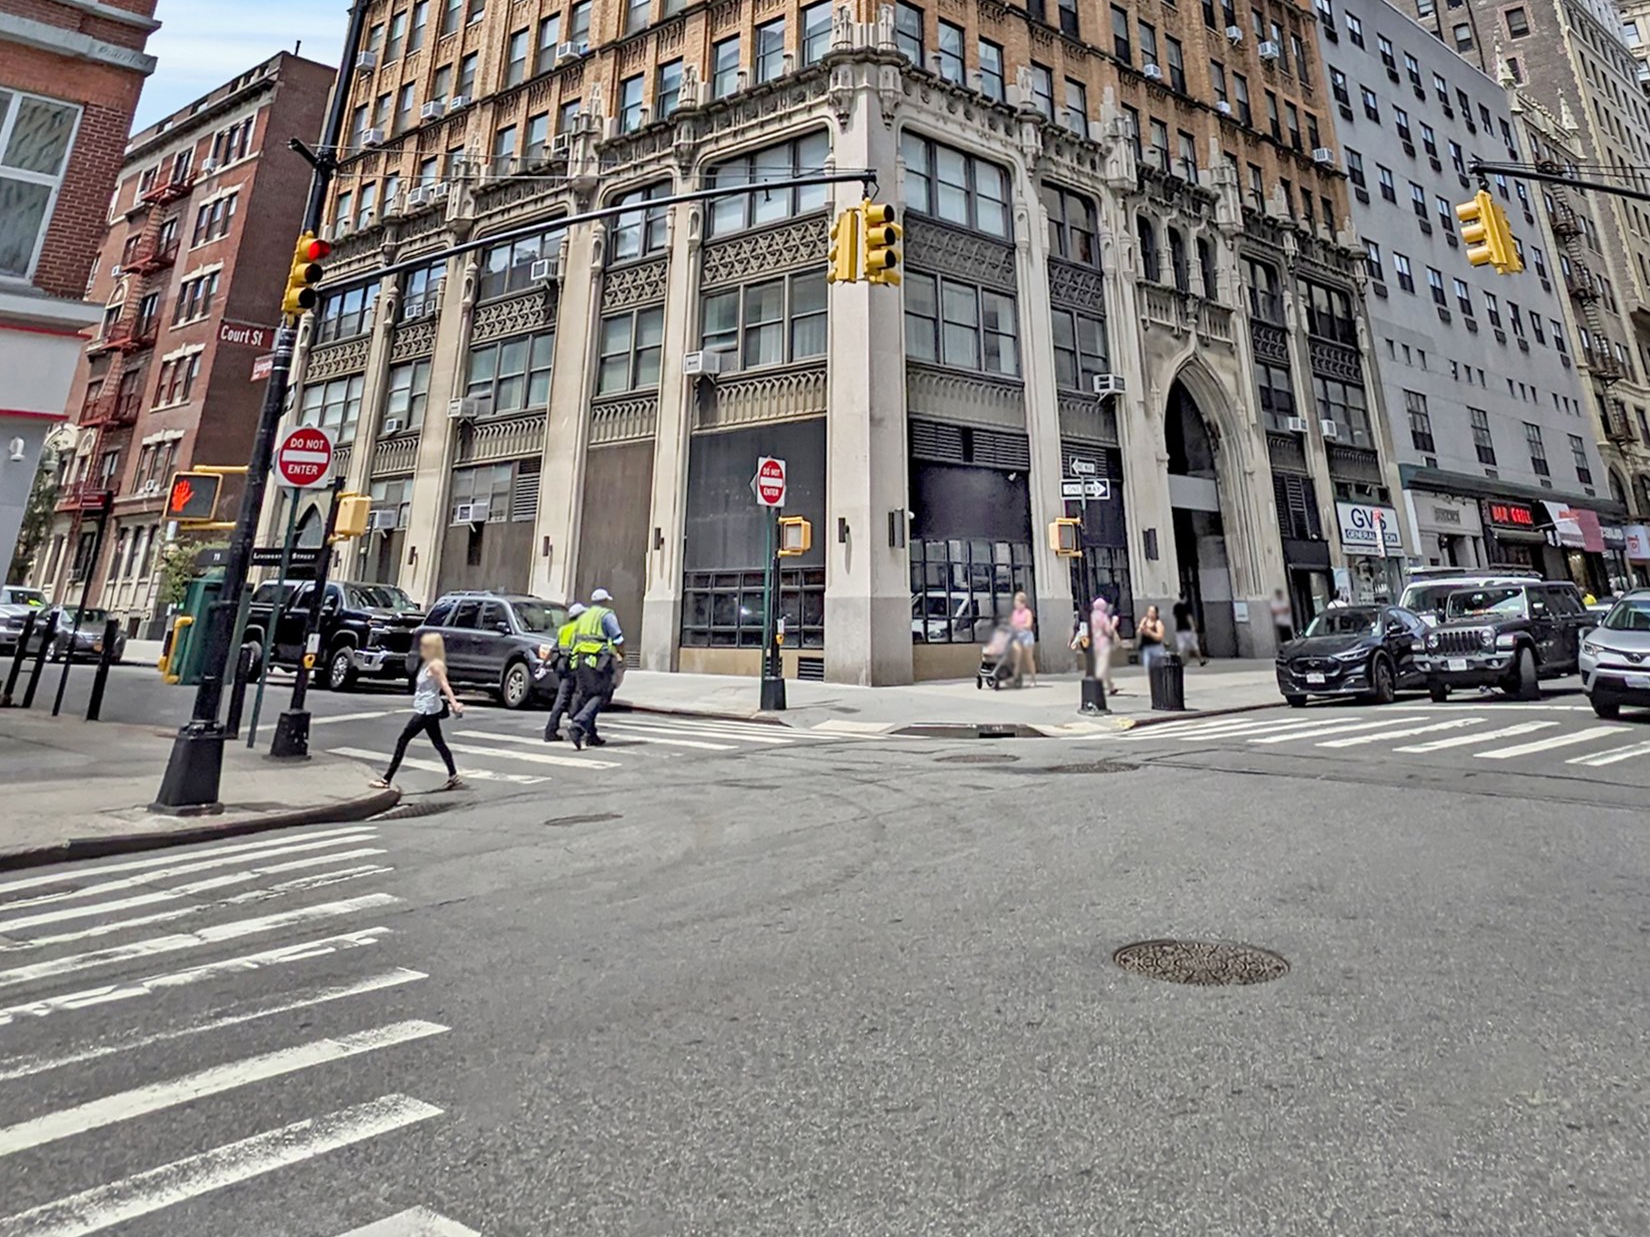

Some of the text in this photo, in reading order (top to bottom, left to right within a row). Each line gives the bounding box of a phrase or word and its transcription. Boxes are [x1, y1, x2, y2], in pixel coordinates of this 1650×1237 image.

[220, 325, 263, 346] Court St
[290, 438, 324, 450] DO NOT
[288, 464, 318, 475] ENTER
[763, 467, 780, 477] DO NOT
[763, 487, 779, 496] ENTER
